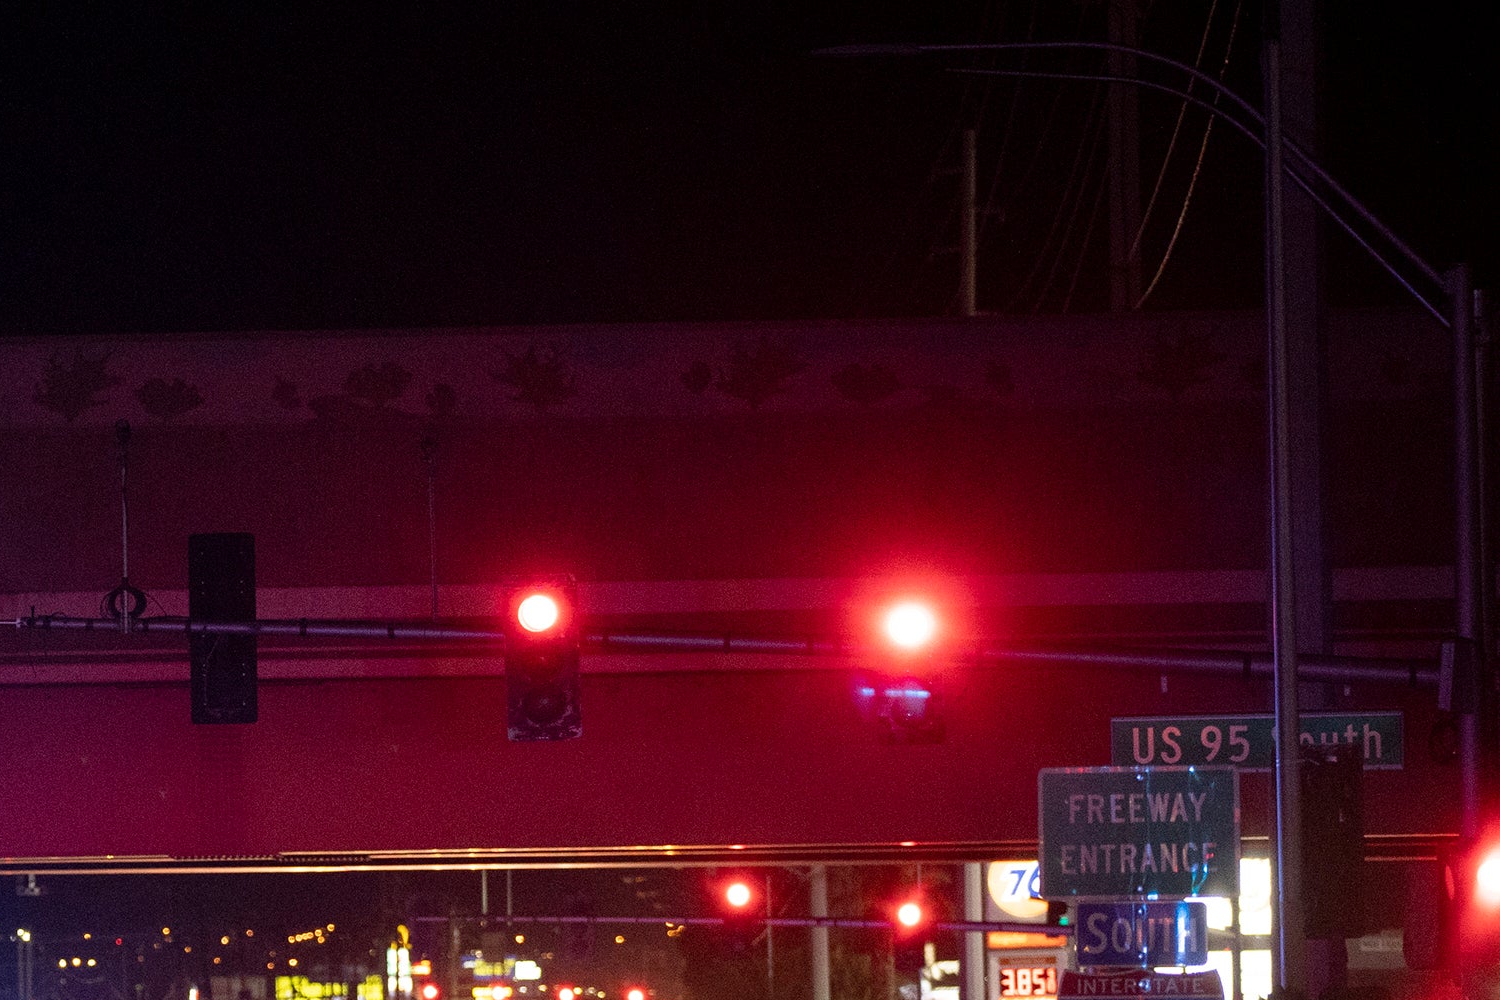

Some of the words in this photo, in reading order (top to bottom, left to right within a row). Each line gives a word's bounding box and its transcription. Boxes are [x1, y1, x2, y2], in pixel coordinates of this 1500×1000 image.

[1132, 726, 1183, 764] US
[1201, 725, 1250, 762] 95
[1271, 723, 1382, 759] outh
[1068, 792, 1206, 823] FREEWAY
[1061, 842, 1217, 874] ENTRANCE
[1086, 912, 1198, 953] SOUTH
[1077, 978, 1204, 994] INTERSTATE
